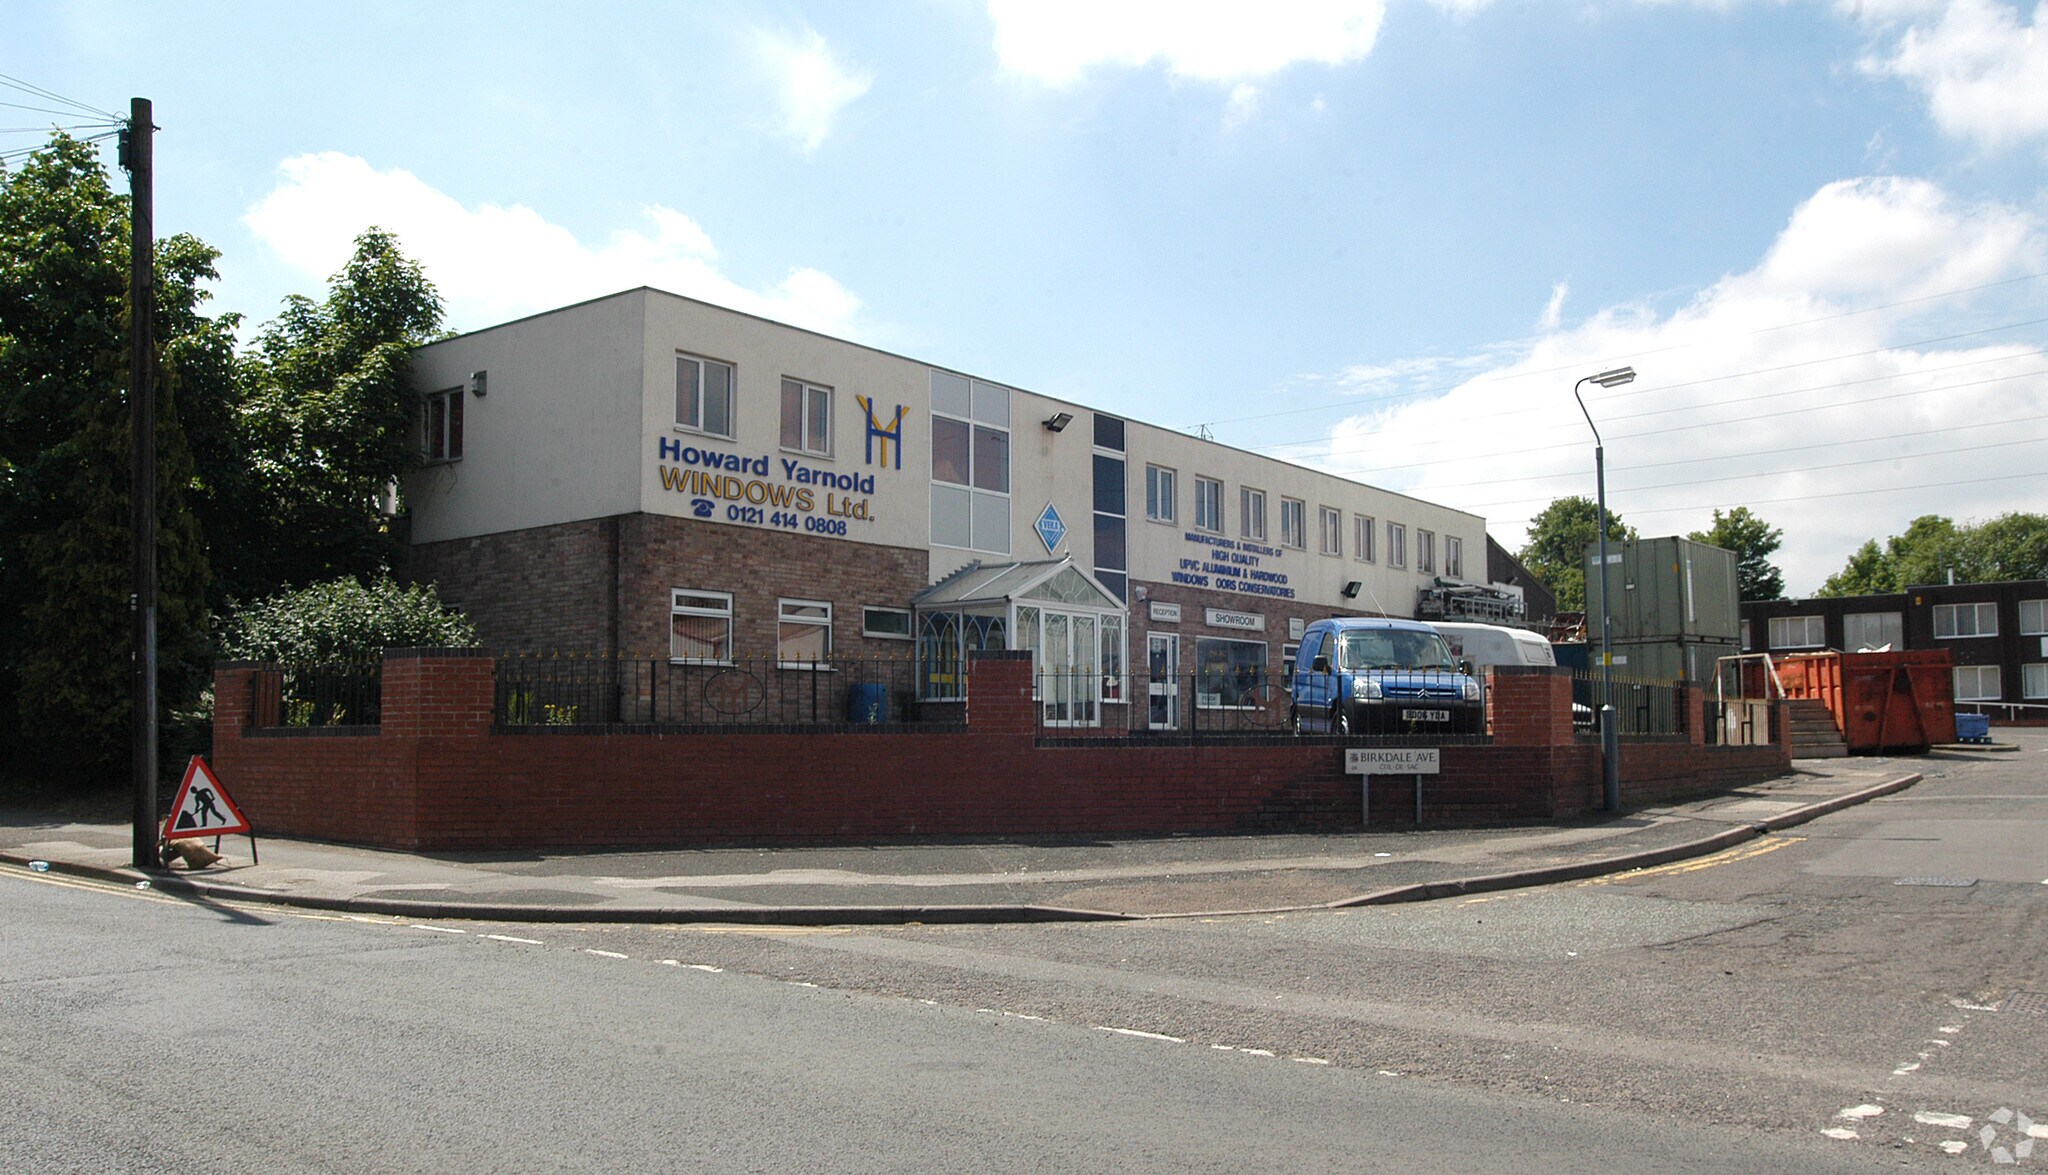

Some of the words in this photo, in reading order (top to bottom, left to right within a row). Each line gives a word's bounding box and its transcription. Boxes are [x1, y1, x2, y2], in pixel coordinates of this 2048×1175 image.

[659, 436, 769, 477] Howard
[782, 458, 876, 495] Yarnold
[660, 464, 815, 512] WINDOWS
[828, 492, 875, 522] Ltd.
[727, 504, 764, 525] 0121
[770, 511, 799, 530] 414
[805, 516, 848, 536] 0808
[1184, 531, 1235, 550] MANUFACTURERS
[1242, 542, 1274, 557] INSTALLERS
[1275, 549, 1283, 558] OF
[1211, 549, 1230, 562] HIGH
[1230, 552, 1260, 567] QUALITY
[1171, 571, 1209, 587] WINDOWS
[1238, 581, 1296, 599] CONSERVATORIES
[1242, 568, 1248, 579] &
[1250, 569, 1289, 585] HARDWOOD
[1152, 607, 1178, 617] RECEPTION
[1215, 613, 1256, 627] SHOWROOM
[1360, 752, 1412, 763] BIRKDALE
